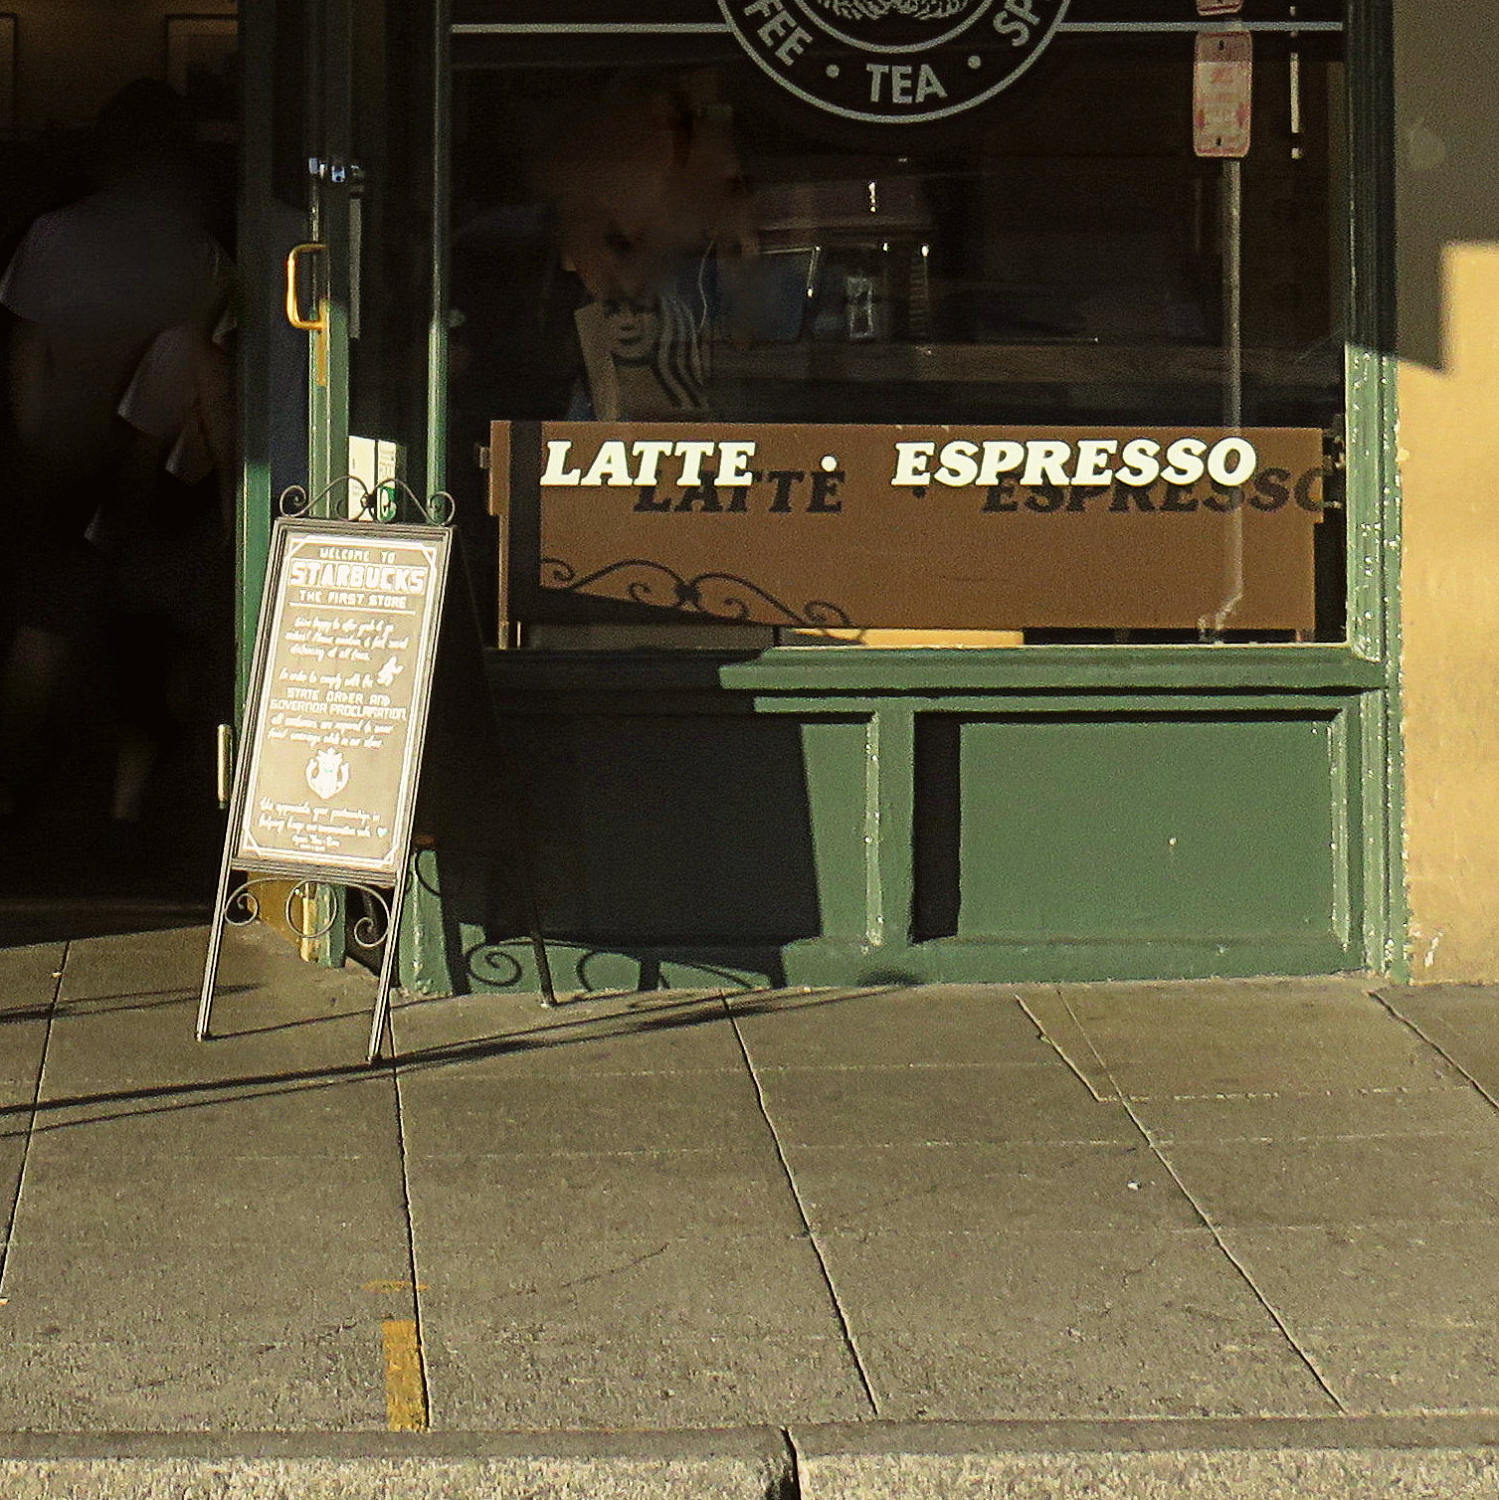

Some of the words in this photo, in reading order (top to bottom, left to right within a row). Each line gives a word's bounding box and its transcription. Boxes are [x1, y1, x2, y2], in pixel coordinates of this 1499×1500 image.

[865, 62, 947, 105] TEA
[539, 439, 757, 488] LATTE
[891, 437, 1257, 488] ESPRESSO
[319, 547, 370, 562] WELCOME
[381, 551, 396, 564] TO
[289, 561, 425, 593] STARBUCKS
[299, 590, 322, 603] THE
[328, 592, 365, 605] FIRST
[368, 595, 407, 609] STORE
[286, 687, 320, 700] STATE
[269, 699, 328, 714] GOVERNOR
